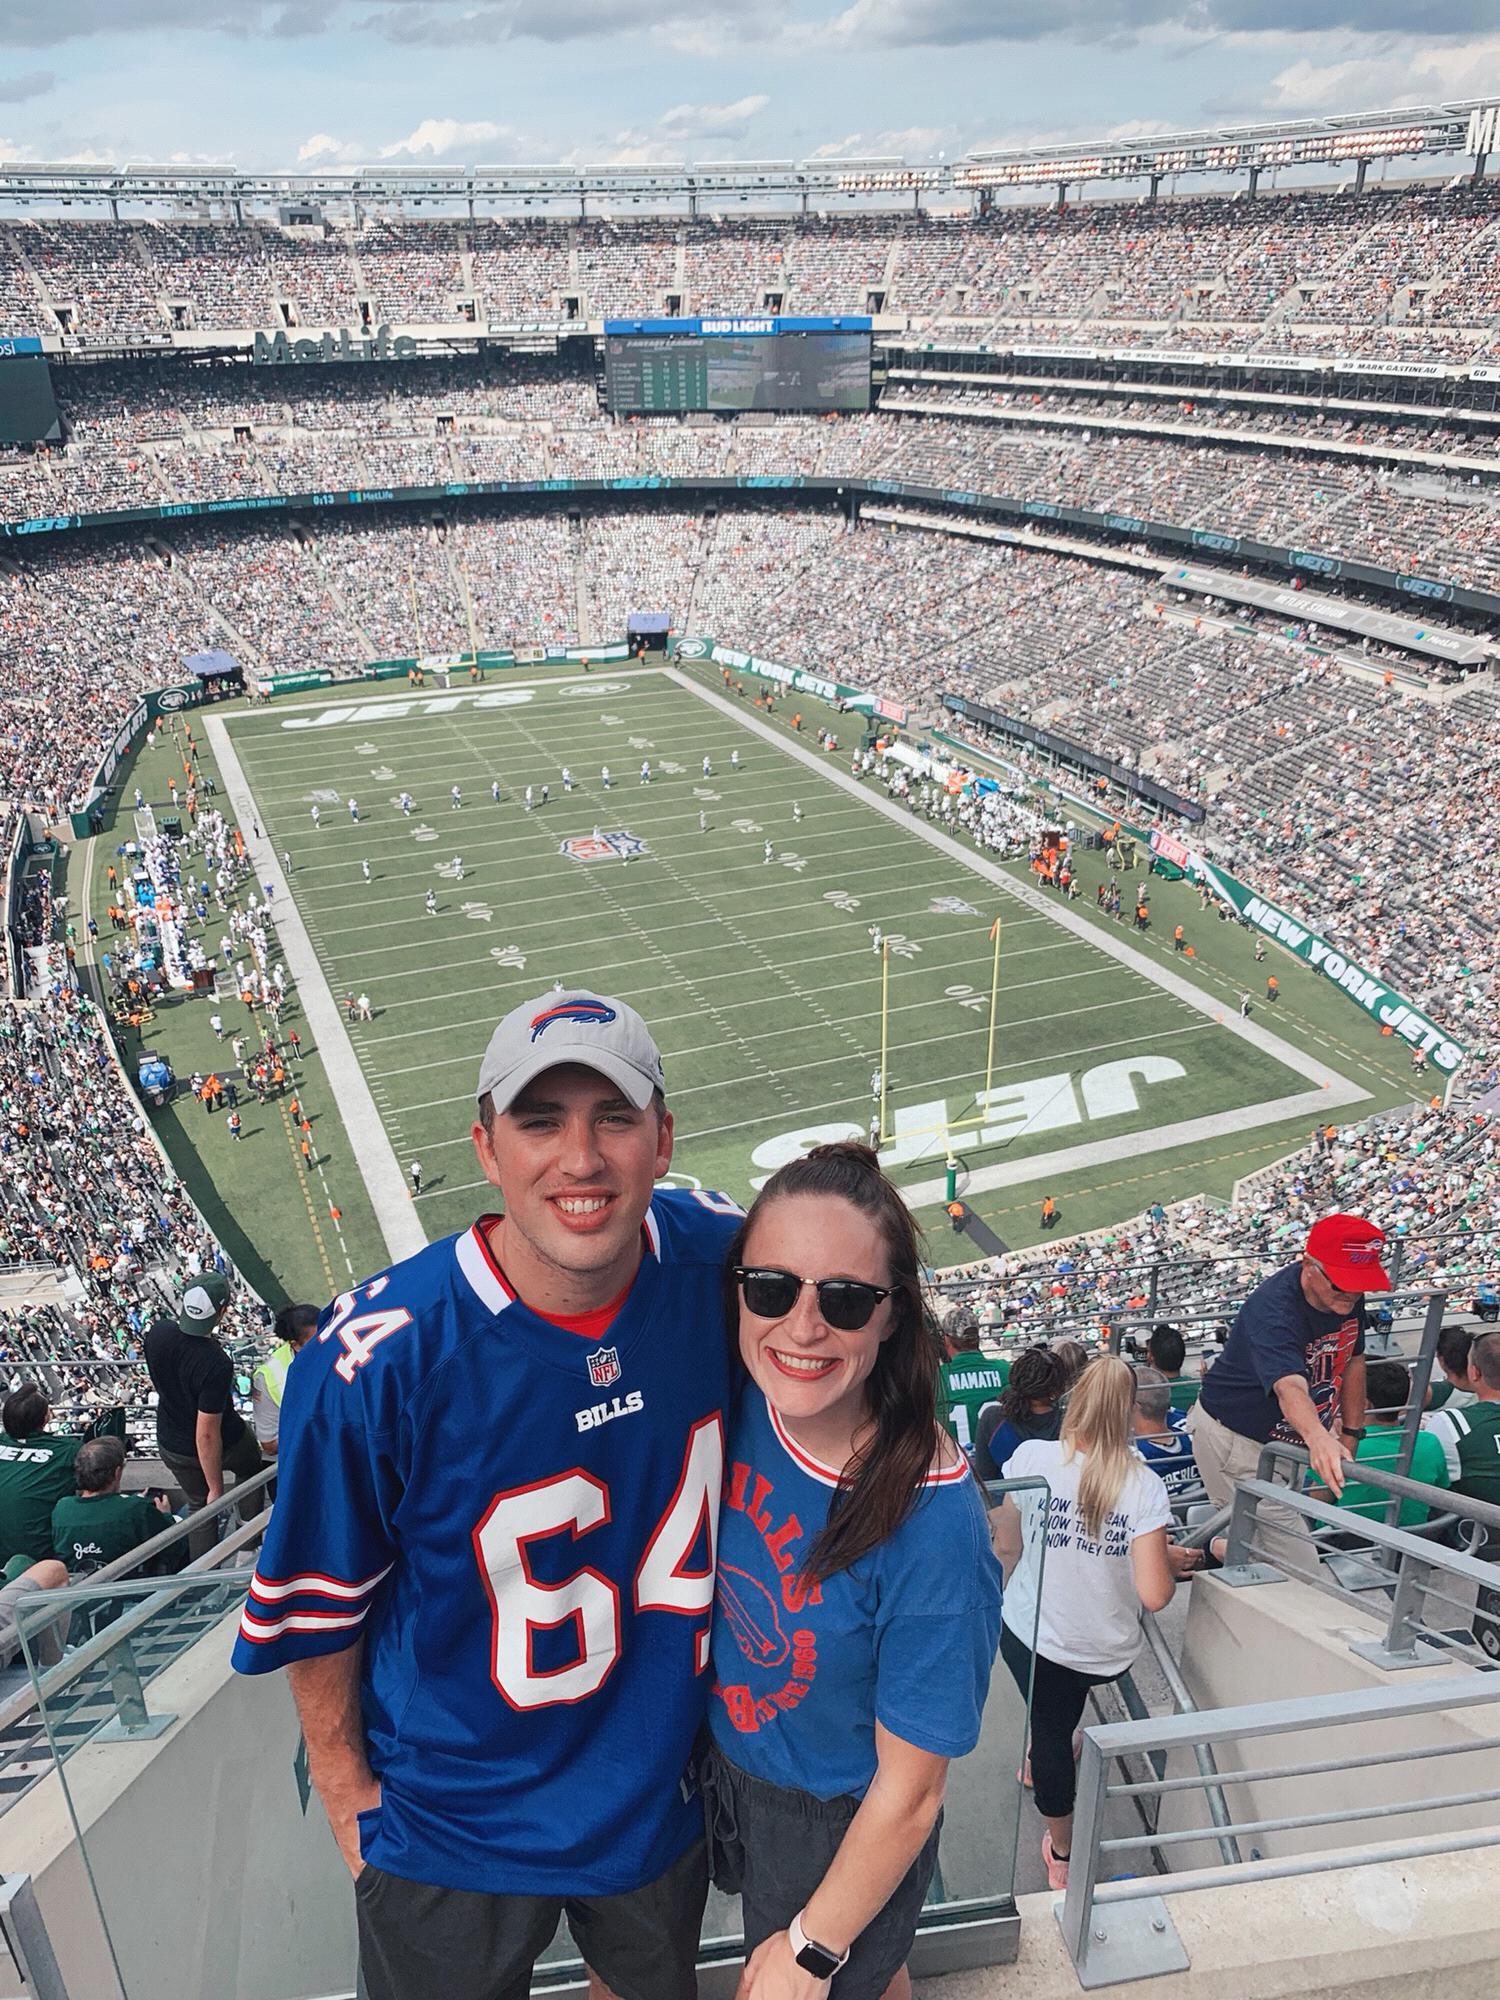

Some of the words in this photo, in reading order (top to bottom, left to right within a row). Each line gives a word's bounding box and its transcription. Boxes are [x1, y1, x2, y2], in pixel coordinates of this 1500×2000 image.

[701, 320, 732, 333] BUD
[733, 319, 774, 333] LIGHT
[254, 325, 417, 366] MetLife
[1357, 364, 1384, 372] MARK
[1385, 365, 1439, 375] GASTINEAU
[1473, 369, 1488, 378] 60
[16, 517, 71, 535] JETS
[1295, 552, 1335, 573] JETS
[1402, 577, 1447, 600] JETS
[711, 645, 752, 669] NEW
[751, 657, 796, 685] YORK
[795, 671, 838, 700] JETS
[281, 690, 536, 729] JETS
[822, 890, 862, 910] 30
[490, 944, 527, 967] 30
[880, 934, 923, 957] 20
[1242, 896, 1310, 949] NEW
[1306, 939, 1387, 1010] YORK
[1379, 1005, 1465, 1070] JETS
[944, 984, 990, 1009] 10
[750, 1055, 1188, 1191] JETS
[593, 1362, 619, 1383] NFL
[949, 1370, 1002, 1391] NAMATH
[574, 1390, 645, 1434] BILLS
[949, 1400, 1003, 1446] 1
[0, 1444, 54, 1464] ETS
[1038, 1497, 1071, 1513] KOW
[722, 1461, 825, 1614] ILLS
[1044, 1533, 1072, 1548] NOW
[1076, 1537, 1102, 1556] THEY
[1105, 1544, 1129, 1557] CAN
[73, 1541, 103, 1560] Jets
[472, 1409, 724, 1713] 64
[792, 1629, 818, 1682] 1960
